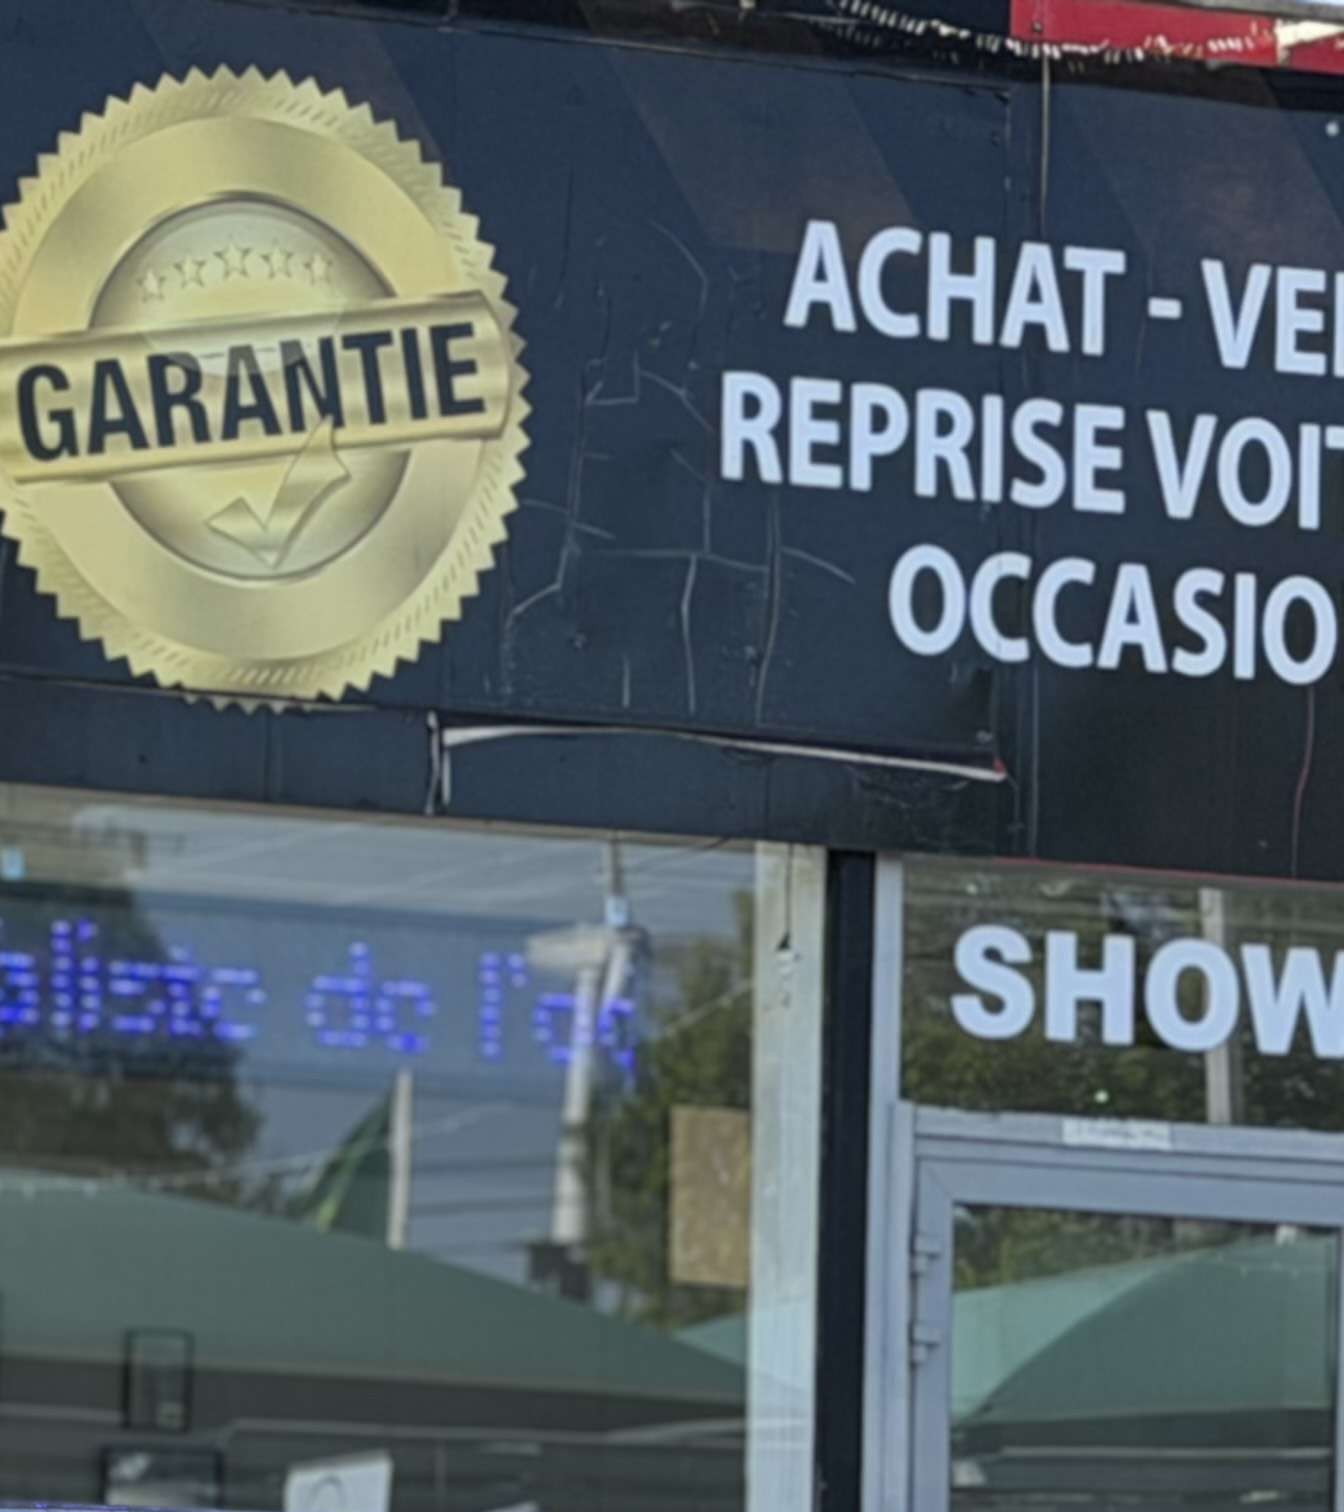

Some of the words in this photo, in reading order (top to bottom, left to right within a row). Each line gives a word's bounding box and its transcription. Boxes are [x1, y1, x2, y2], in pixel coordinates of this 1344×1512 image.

[783, 220, 1126, 356] ACHAT
[1201, 258, 1344, 378] VE
[16, 322, 486, 463] GARANTIE
[721, 370, 1125, 515] REPRISE
[888, 543, 1338, 686] OCCASIO
[308, 940, 438, 1056] de
[950, 925, 1344, 1059] SHOW
